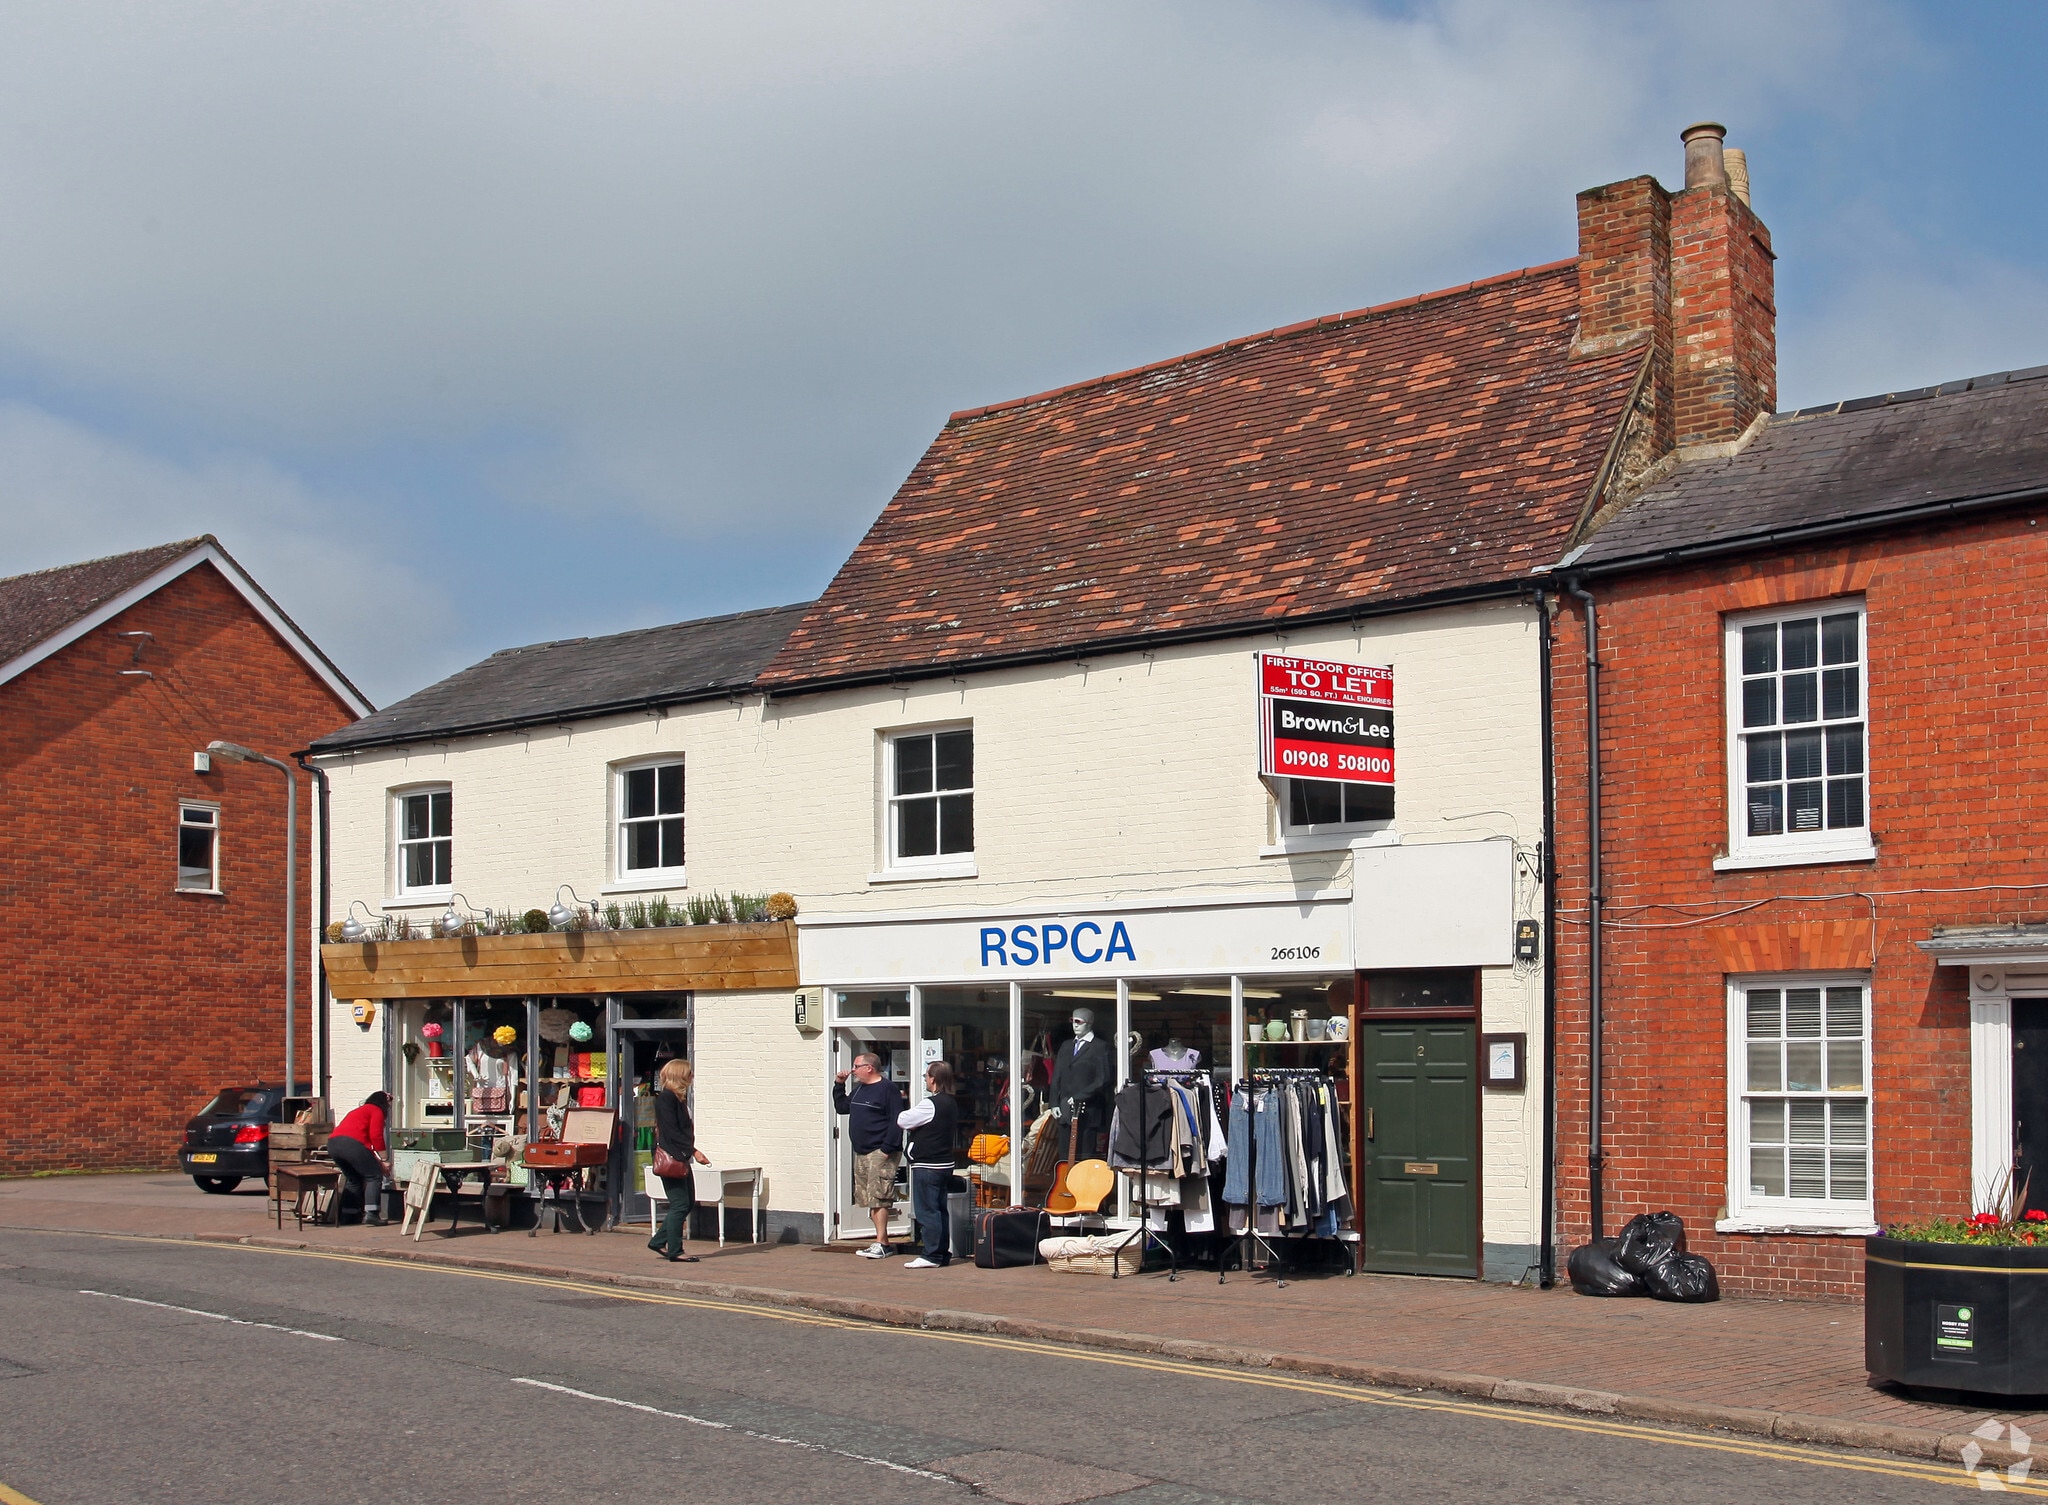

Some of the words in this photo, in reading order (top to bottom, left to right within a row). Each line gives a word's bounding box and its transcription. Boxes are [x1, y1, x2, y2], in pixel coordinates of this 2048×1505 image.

[1266, 656, 1299, 669] FIRST
[1303, 661, 1344, 674] FLOOR
[1347, 667, 1393, 680] OFFICES
[1285, 669, 1321, 688] TO
[1332, 675, 1377, 694] LET
[1291, 687, 1308, 696] (593
[1309, 690, 1322, 698] SQ.
[1324, 691, 1338, 699] FT.)
[1356, 696, 1392, 705] ENQUIRIES
[1282, 749, 1329, 768] 01908
[1337, 754, 1391, 773] 508100
[980, 920, 1137, 967] RSPCA
[1270, 945, 1321, 960] 266106
[1417, 1045, 1425, 1057] 2
